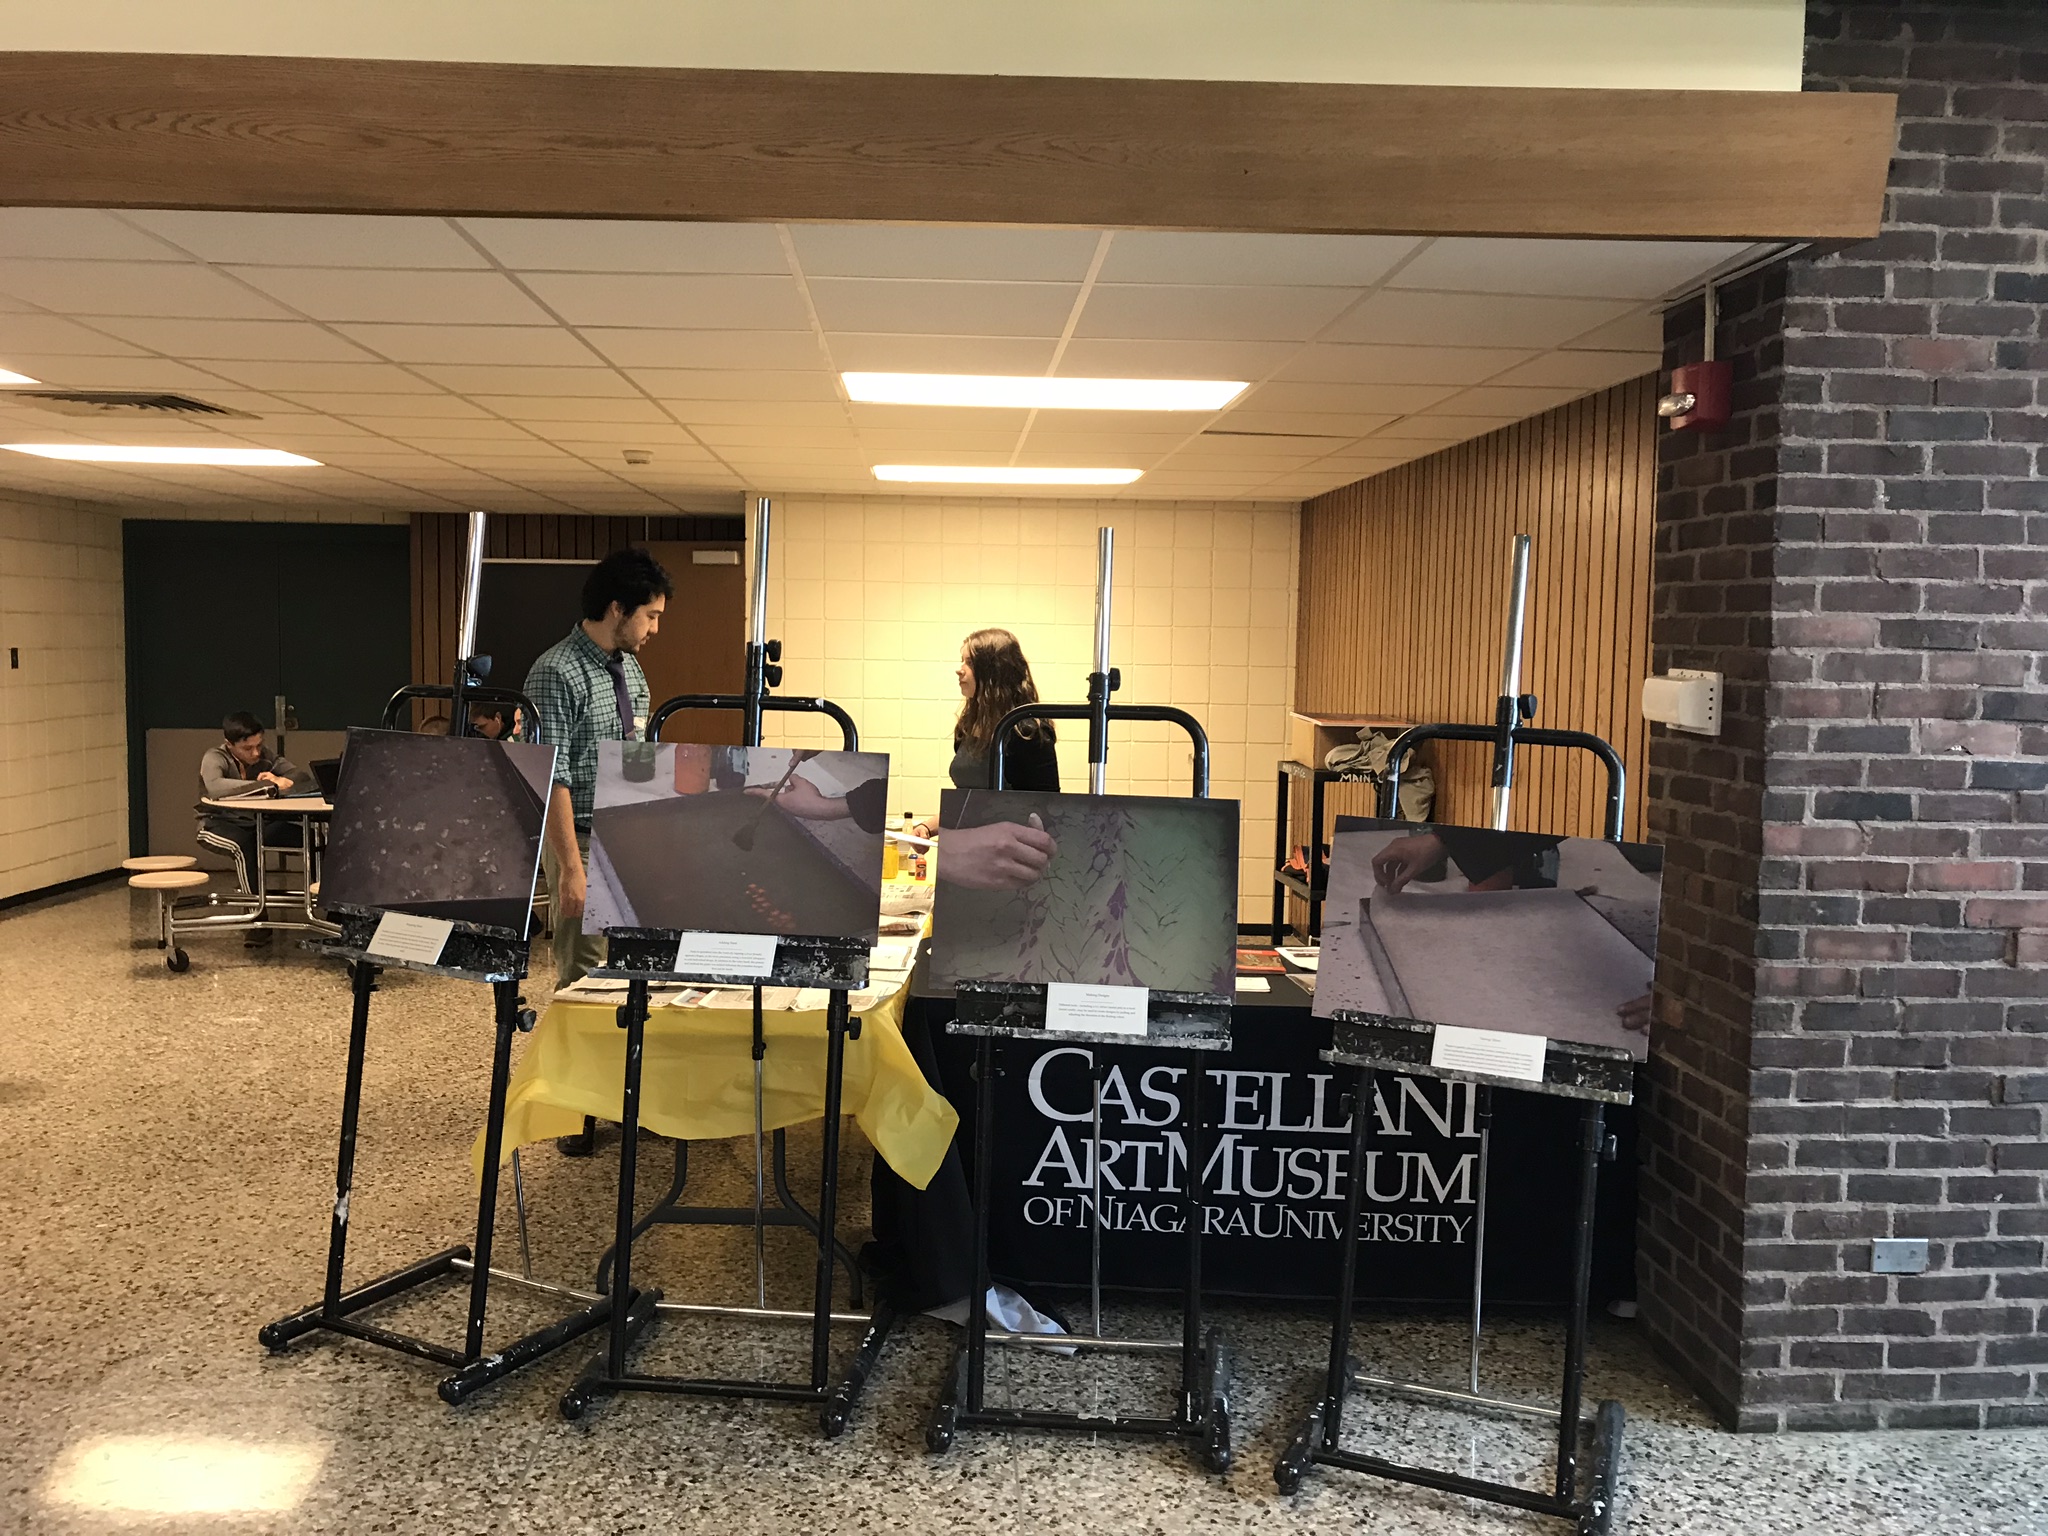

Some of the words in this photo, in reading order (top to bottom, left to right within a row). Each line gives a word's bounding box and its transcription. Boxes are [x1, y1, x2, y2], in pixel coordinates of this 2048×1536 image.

[1339, 772, 1371, 783] MAIN
[1022, 1125, 1163, 1193] ART
[1023, 1196, 1074, 1226] OF
[1076, 1194, 1251, 1236] NIAGRA
